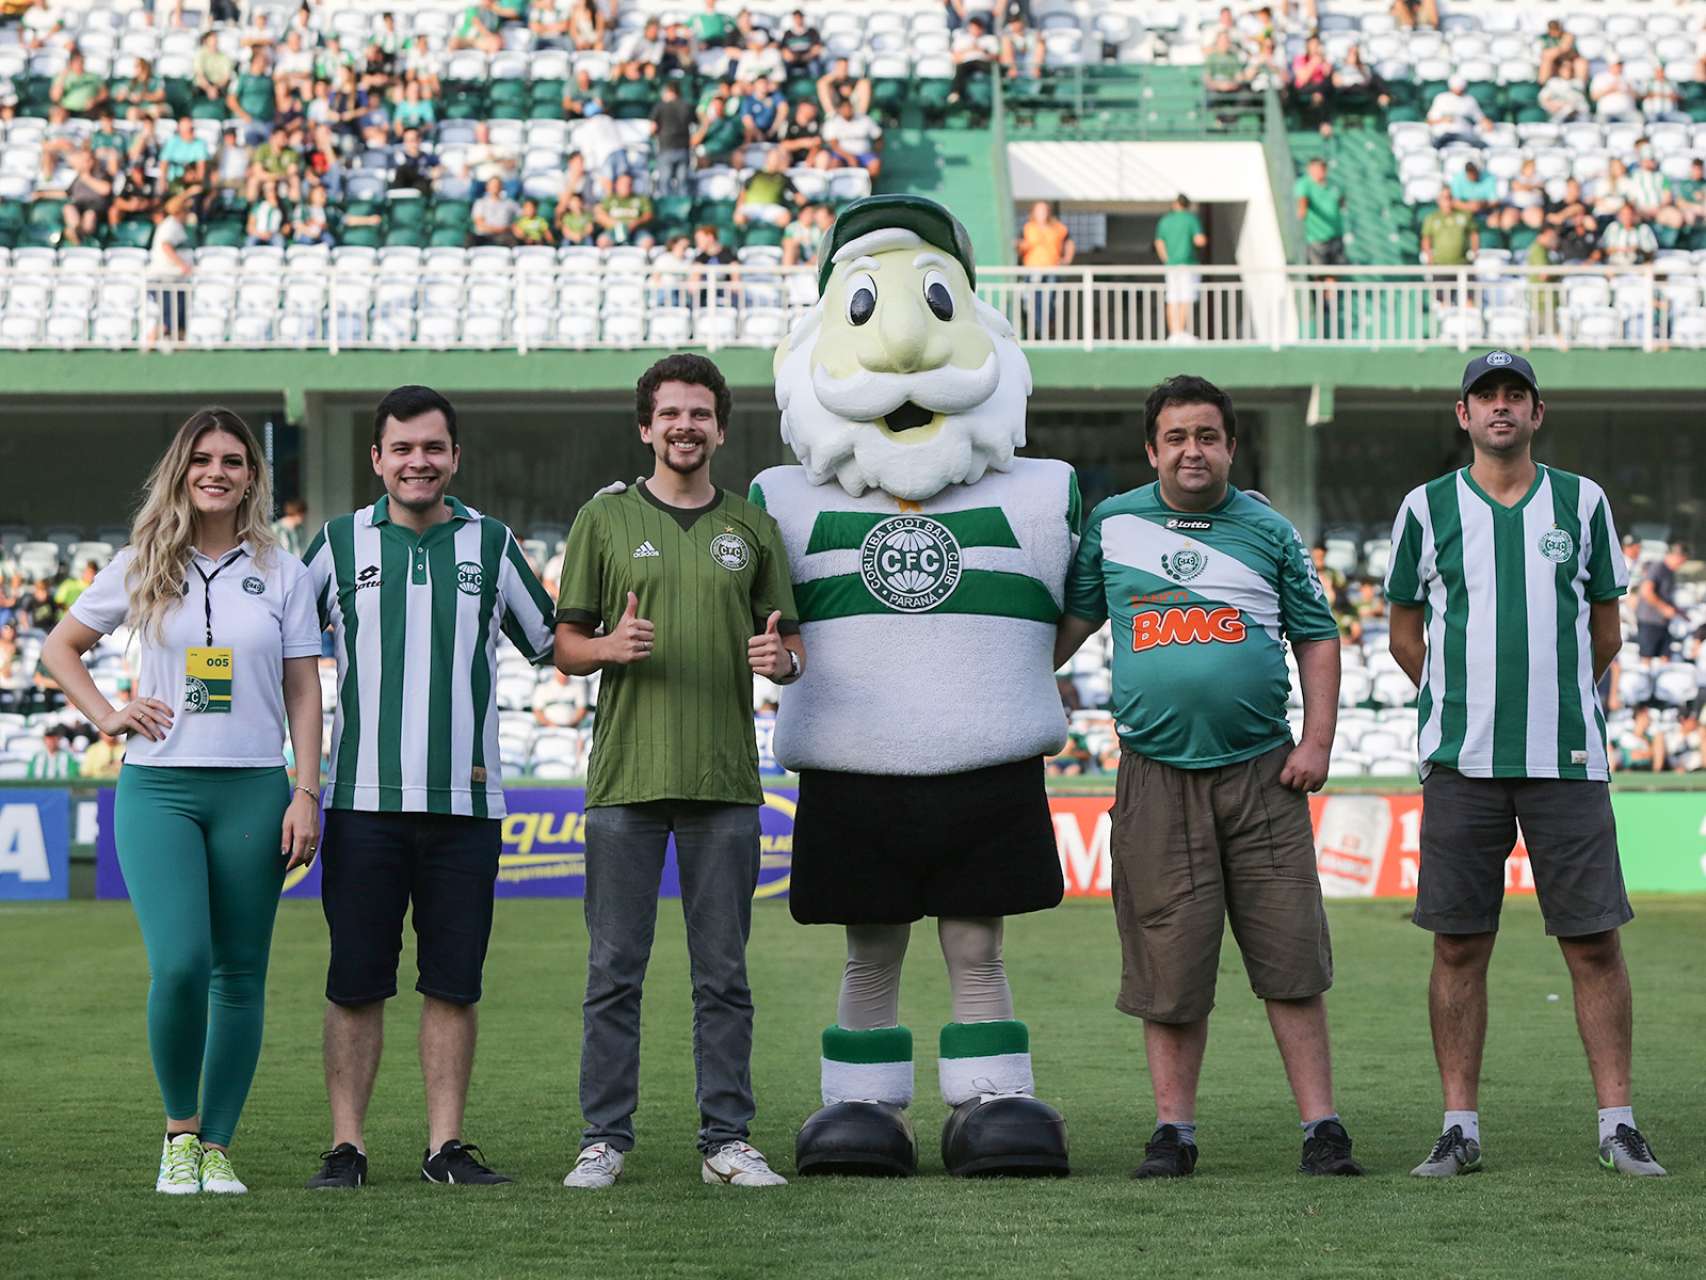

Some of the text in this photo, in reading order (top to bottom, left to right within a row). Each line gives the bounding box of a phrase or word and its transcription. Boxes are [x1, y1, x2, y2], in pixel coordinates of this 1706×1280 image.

[864, 519, 958, 589] CORITIBA FOOT BALL CLUB
[881, 549, 940, 573] CFC
[457, 571, 482, 586] CFC
[1132, 605, 1248, 652] BMG
[207, 658, 229, 667] 005
